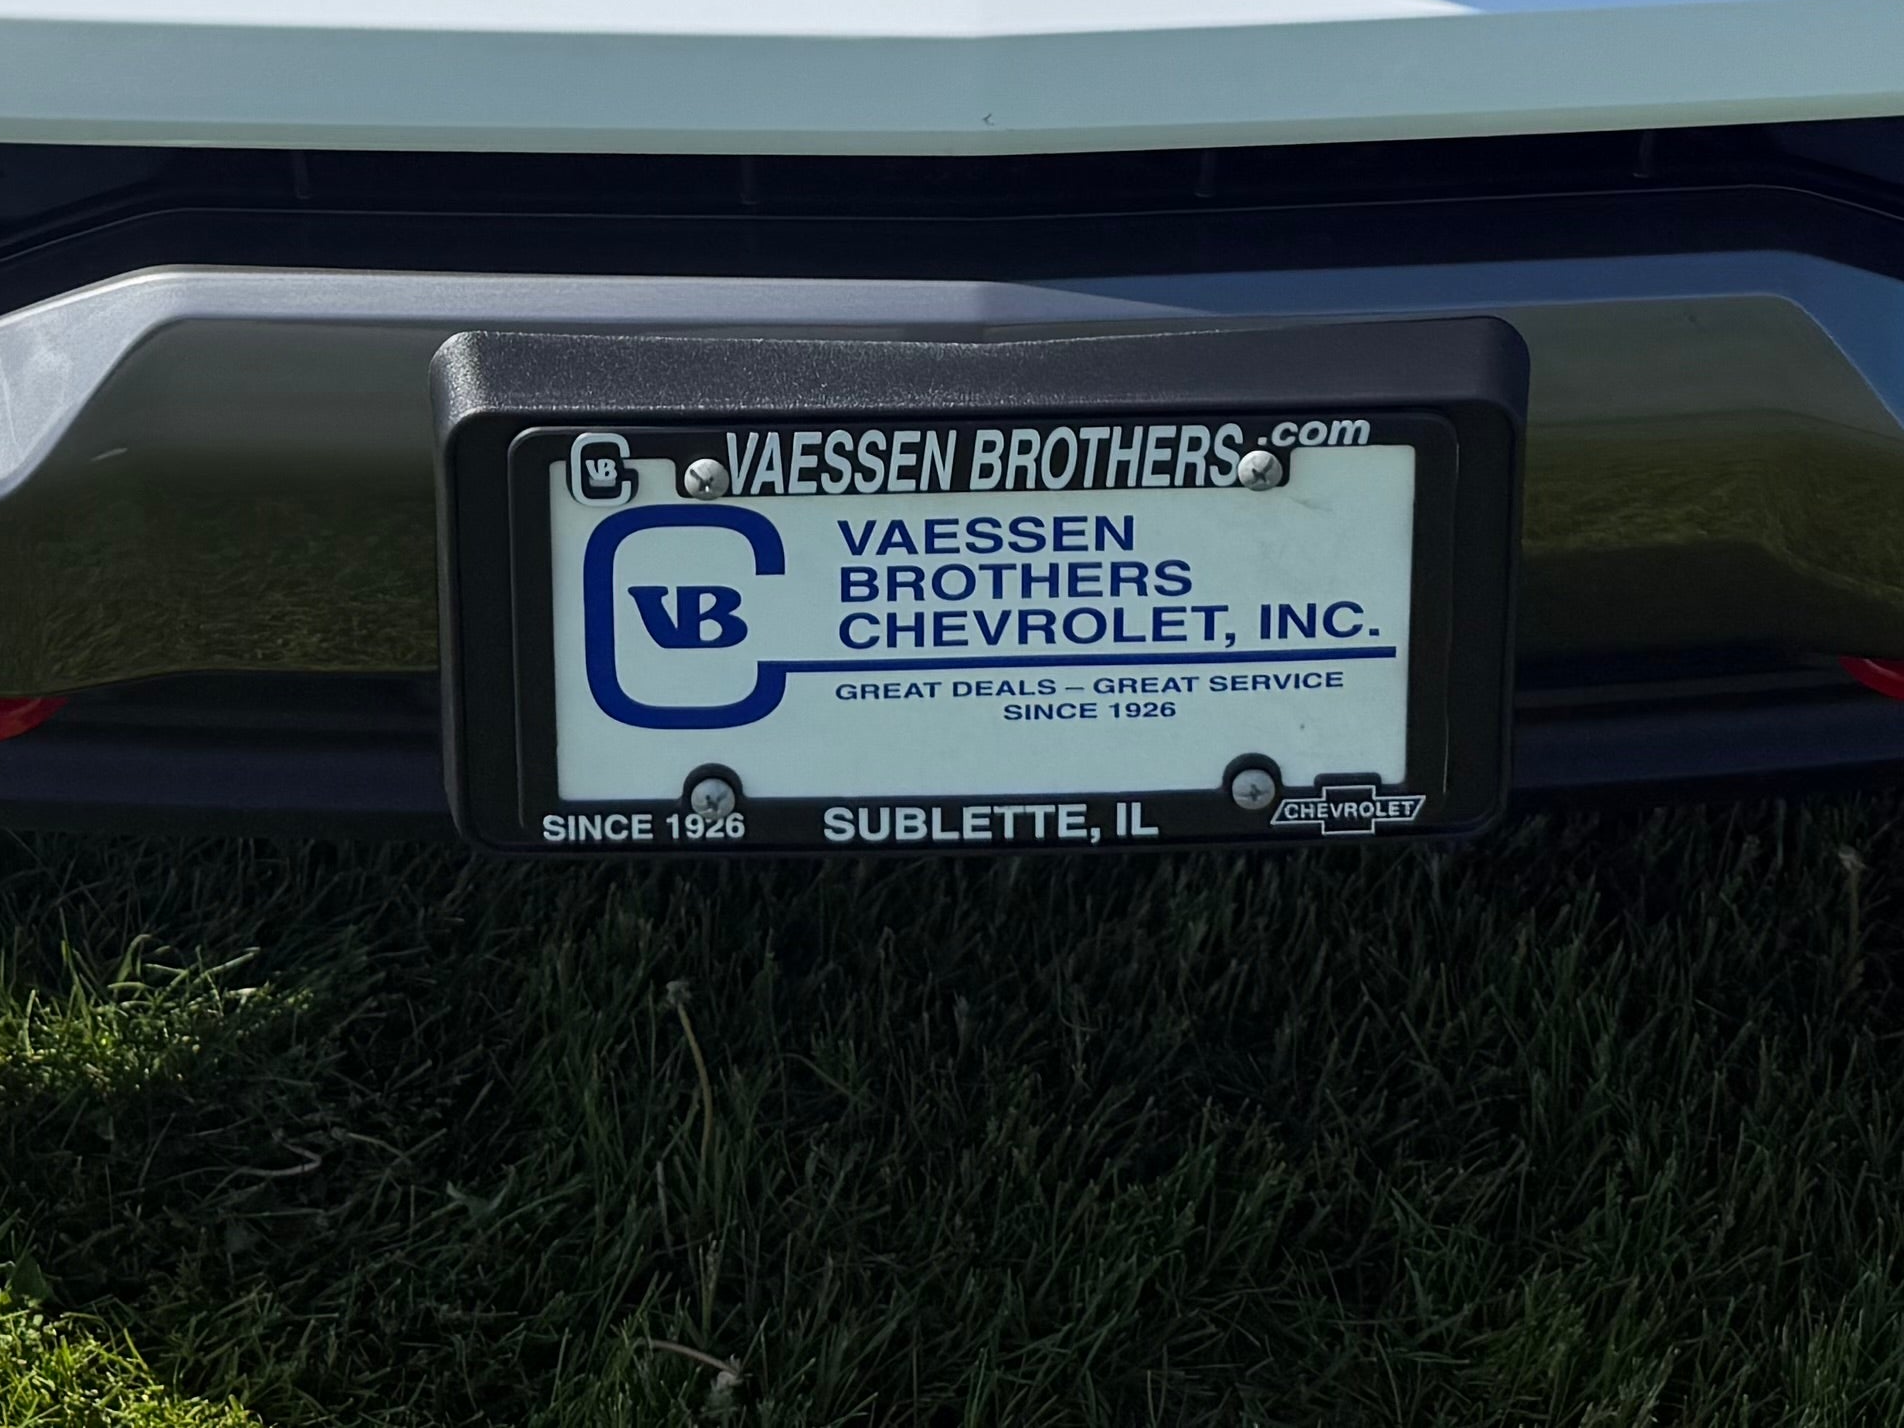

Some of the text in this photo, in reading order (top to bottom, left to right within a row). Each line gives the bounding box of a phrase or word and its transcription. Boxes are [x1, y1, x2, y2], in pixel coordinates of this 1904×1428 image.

[726, 419, 1371, 495] VAESSEN BROTHERS .com
[836, 515, 1134, 556] VAESSEN
[840, 559, 1193, 603] BROTHERS
[838, 600, 1380, 649] CHEVROLET, INC.
[835, 681, 943, 701] GREAT
[952, 678, 1057, 698] DEALS
[1093, 676, 1200, 695] GREAT
[1209, 671, 1344, 693] SERVICE
[1003, 701, 1177, 721] SINCE 1926
[542, 812, 746, 842] SINCE 1926
[823, 801, 1159, 843] SUBLETTE, IL
[1283, 800, 1415, 820] CHEVROLET
